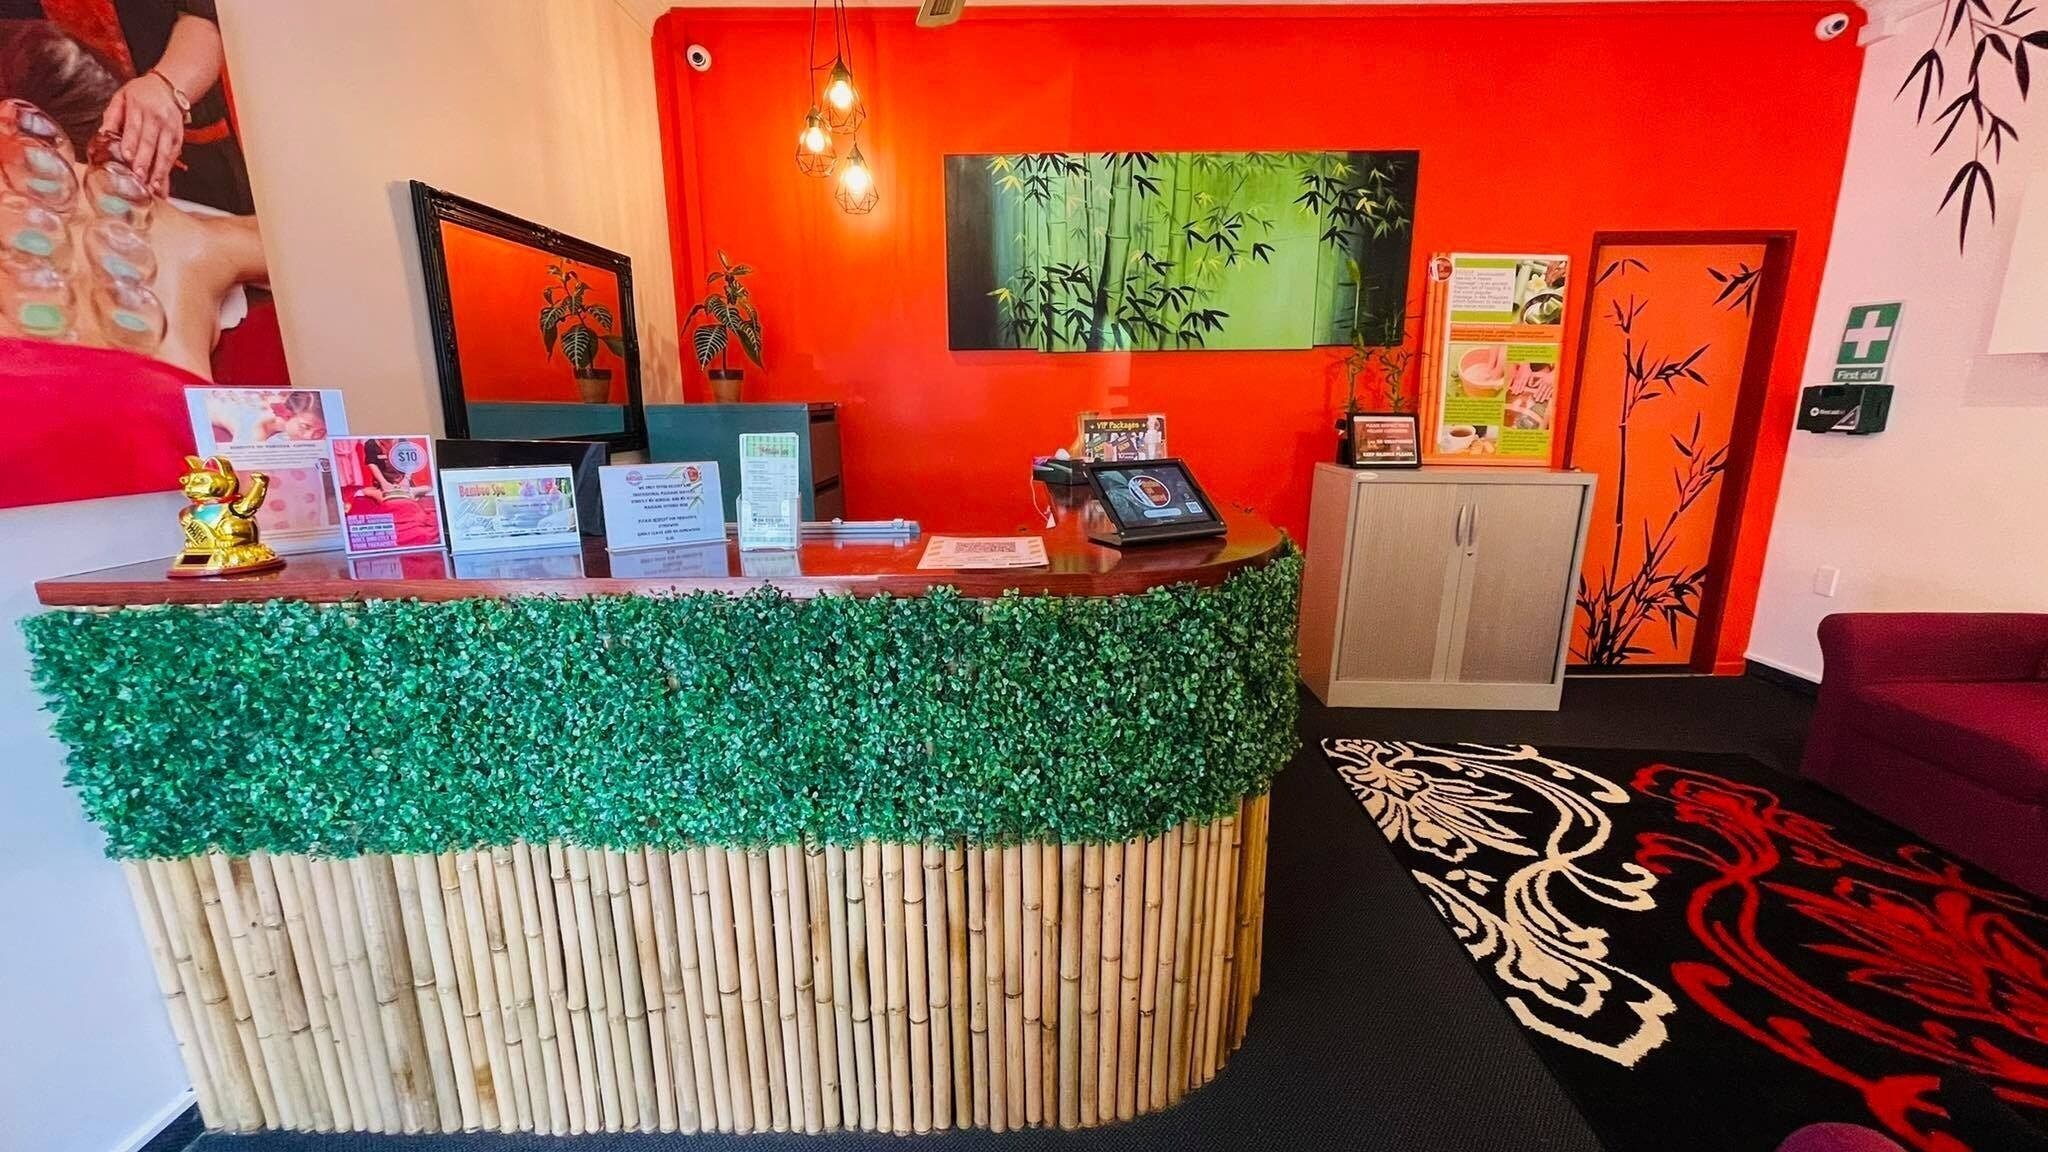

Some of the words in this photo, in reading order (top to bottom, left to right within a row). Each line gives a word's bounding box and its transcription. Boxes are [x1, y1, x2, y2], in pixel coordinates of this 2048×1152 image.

[1837, 371, 1859, 380] First
[1861, 370, 1879, 380] aid
[1097, 422, 1108, 430] VIP
[1109, 421, 1140, 431] Packages
[398, 452, 417, 462] $10
[459, 485, 491, 497] Bamboo
[492, 484, 506, 497] Spa
